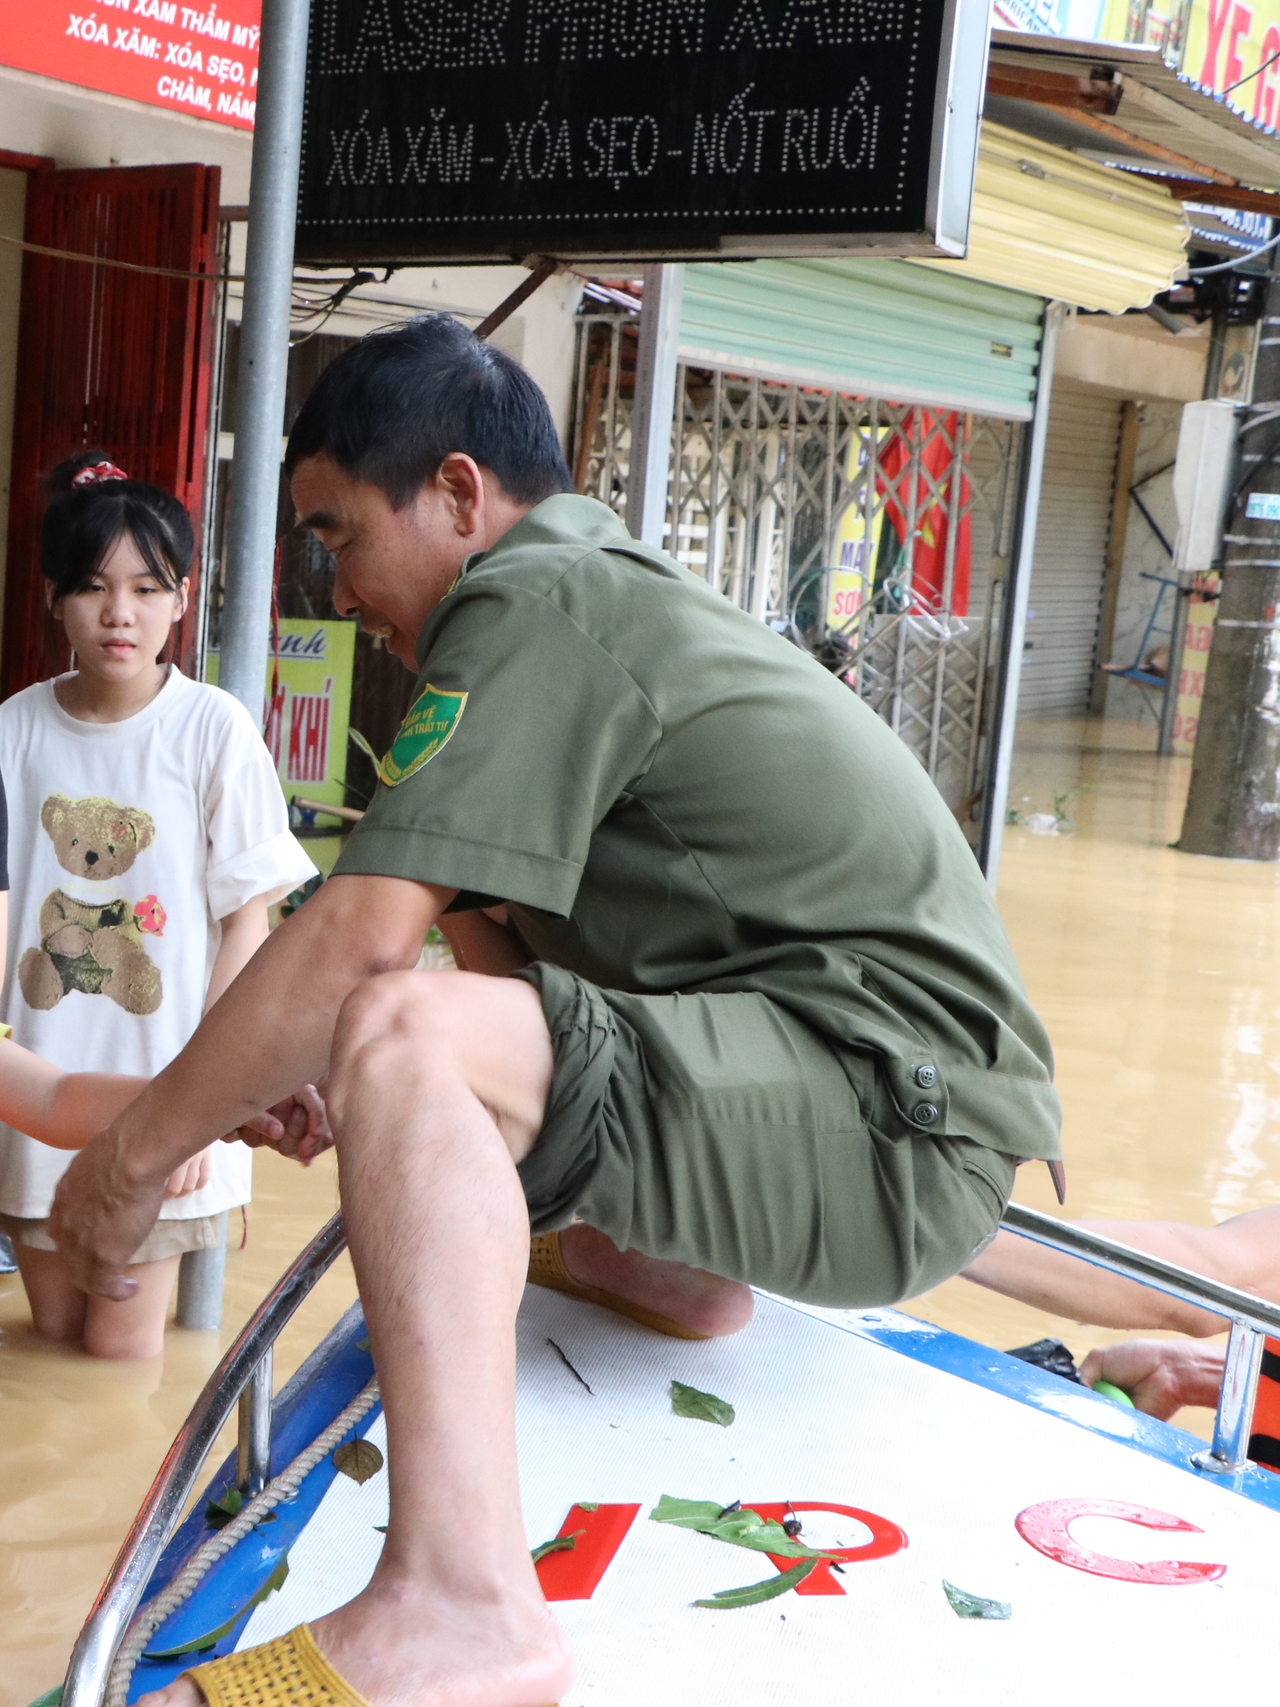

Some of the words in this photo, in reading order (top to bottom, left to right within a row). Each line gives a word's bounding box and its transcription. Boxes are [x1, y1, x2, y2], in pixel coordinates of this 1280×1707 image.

[65, 13, 109, 46] XÓA
[113, 27, 161, 60] XĂM:
[164, 41, 203, 72] XÓA
[206, 54, 246, 87] SẸO,
[180, 3, 231, 41] THẨM
[157, 76, 212, 112] CHÀM,
[326, 110, 396, 186] XÓA
[404, 107, 473, 184] XĂM
[499, 100, 573, 182] XÓA
[584, 114, 660, 192] SẸO
[690, 82, 775, 176] NỐT
